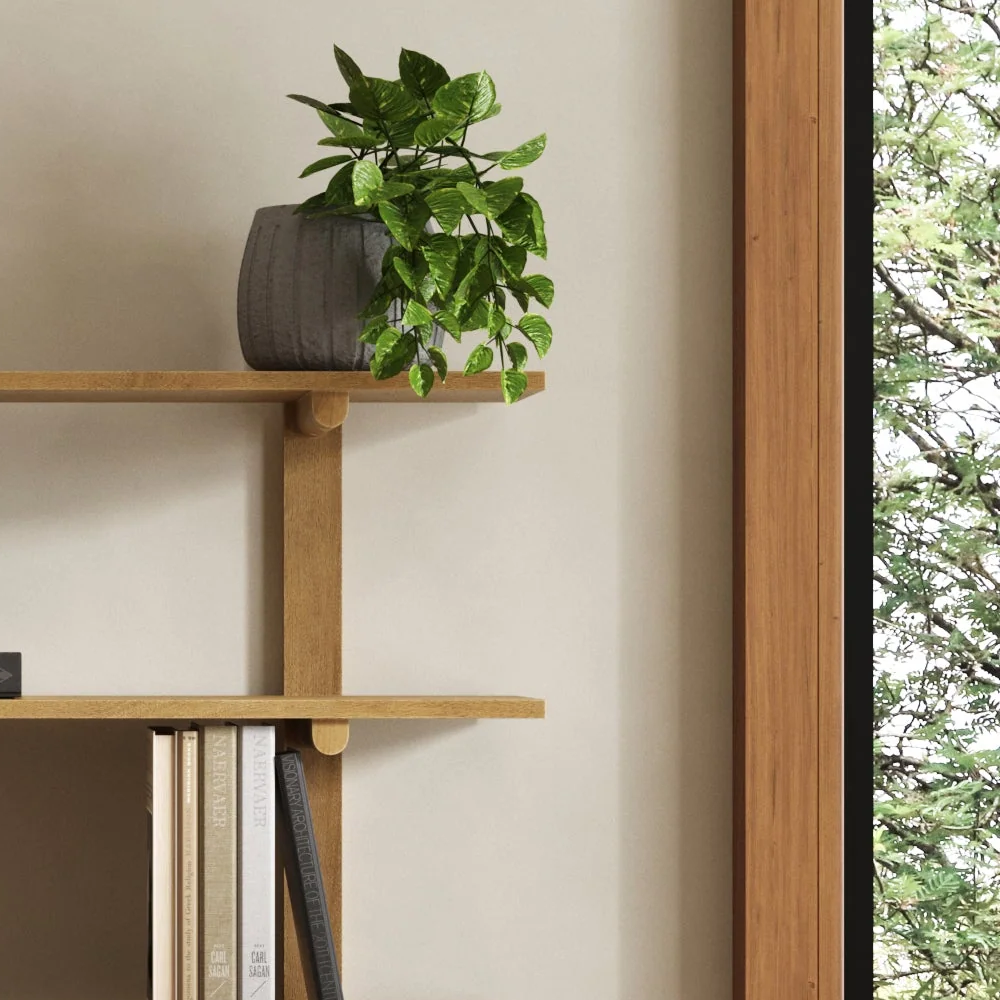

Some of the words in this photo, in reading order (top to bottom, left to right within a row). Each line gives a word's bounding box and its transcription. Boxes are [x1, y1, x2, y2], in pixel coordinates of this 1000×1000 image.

[281, 754, 302, 808] VISIONARY
[292, 808, 317, 891] ARCHITECTURE
[184, 861, 194, 890] Religion
[184, 894, 192, 915] Greek
[305, 890, 320, 908] OF
[308, 908, 324, 930] THE
[184, 929, 194, 947] study
[184, 950, 192, 961] the
[211, 950, 227, 964] CARL
[251, 951, 268, 964] CARL
[208, 965, 230, 978] SAGAN
[249, 965, 270, 978] SAGAN
